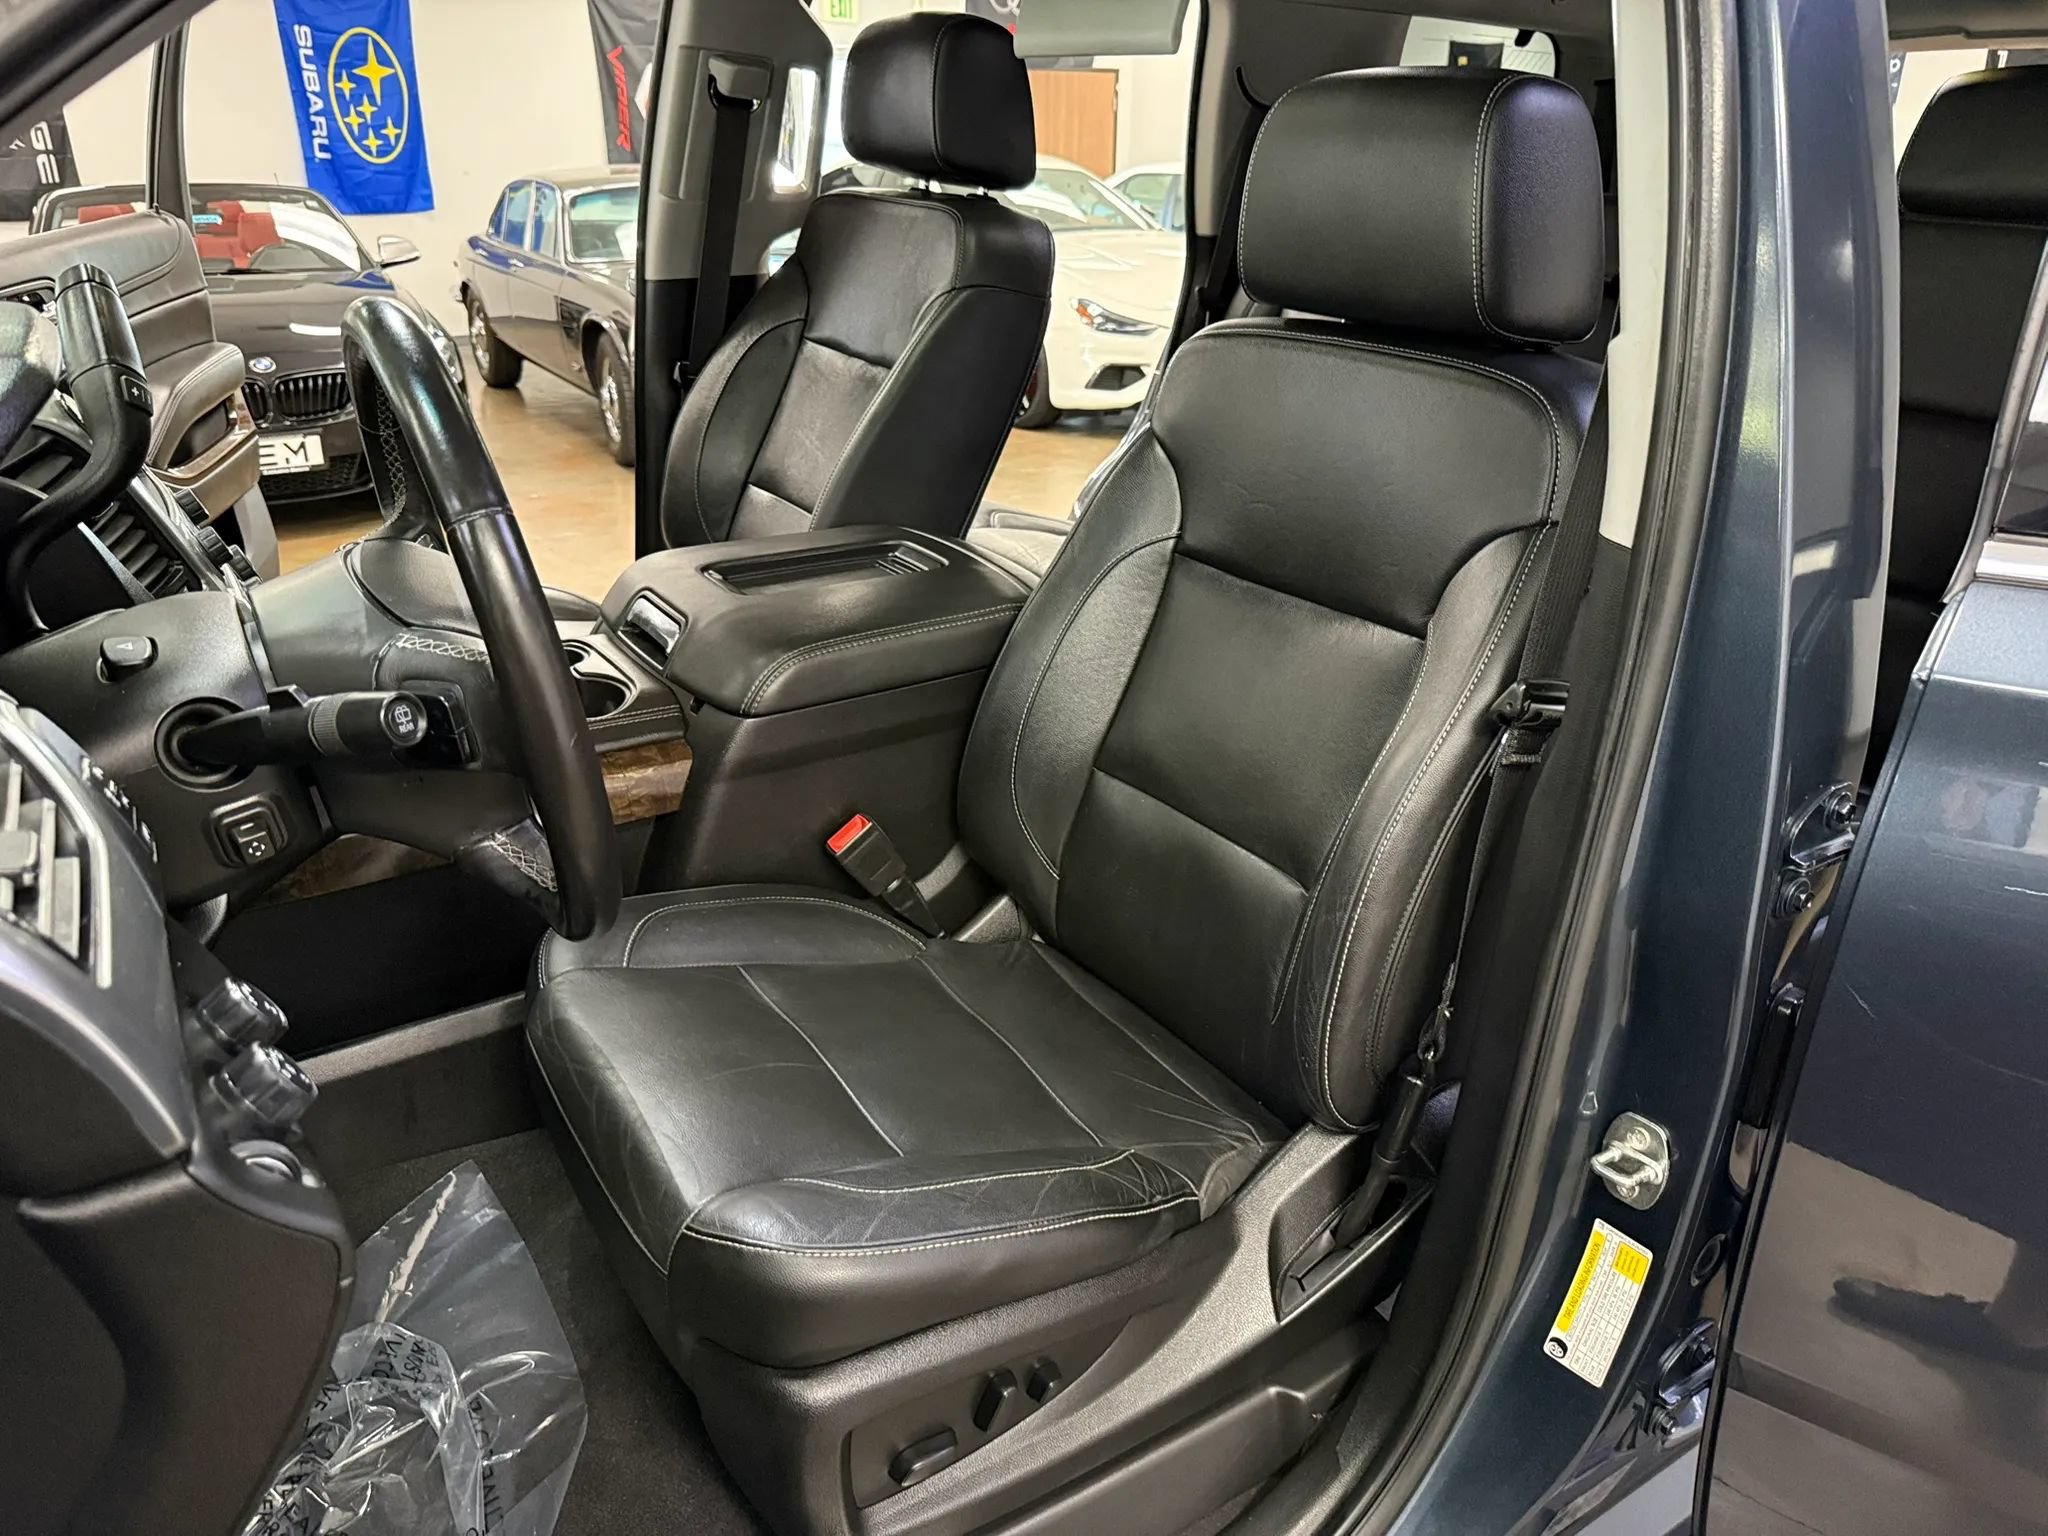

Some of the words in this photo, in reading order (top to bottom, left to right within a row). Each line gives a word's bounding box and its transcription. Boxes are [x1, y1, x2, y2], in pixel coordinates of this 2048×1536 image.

[293, 24, 332, 159] SUBARU
[607, 45, 631, 151] VIPER
[1583, 1243, 1600, 1275] INFORMATION
[1573, 1274, 1588, 1298] LOADING
[1564, 1307, 1574, 1319] TIRE
[1568, 1297, 1579, 1309] AND
